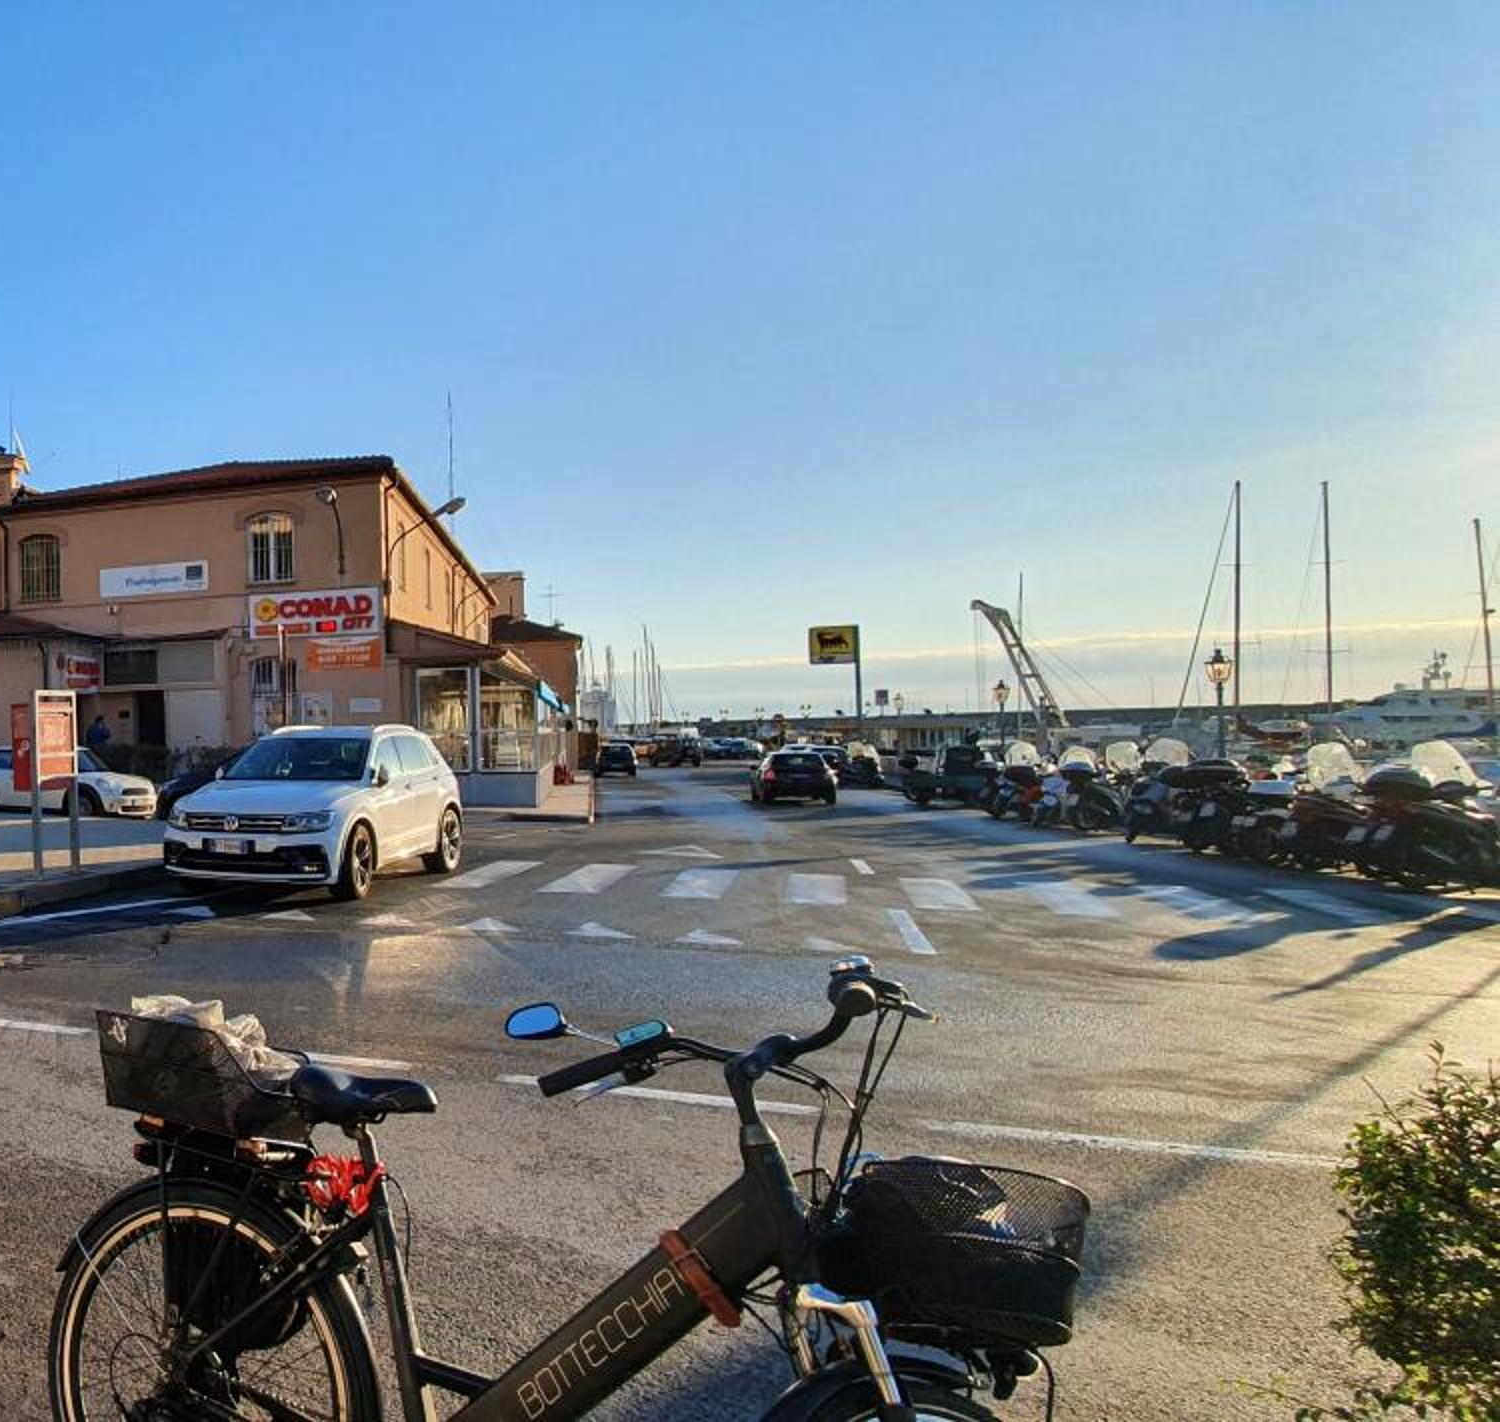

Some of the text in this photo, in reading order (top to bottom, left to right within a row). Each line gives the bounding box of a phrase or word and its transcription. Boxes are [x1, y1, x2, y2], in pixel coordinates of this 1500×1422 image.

[280, 595, 373, 618] CONAD
[342, 615, 375, 630] CITY
[516, 1267, 685, 1420] BOTTECCHIA
